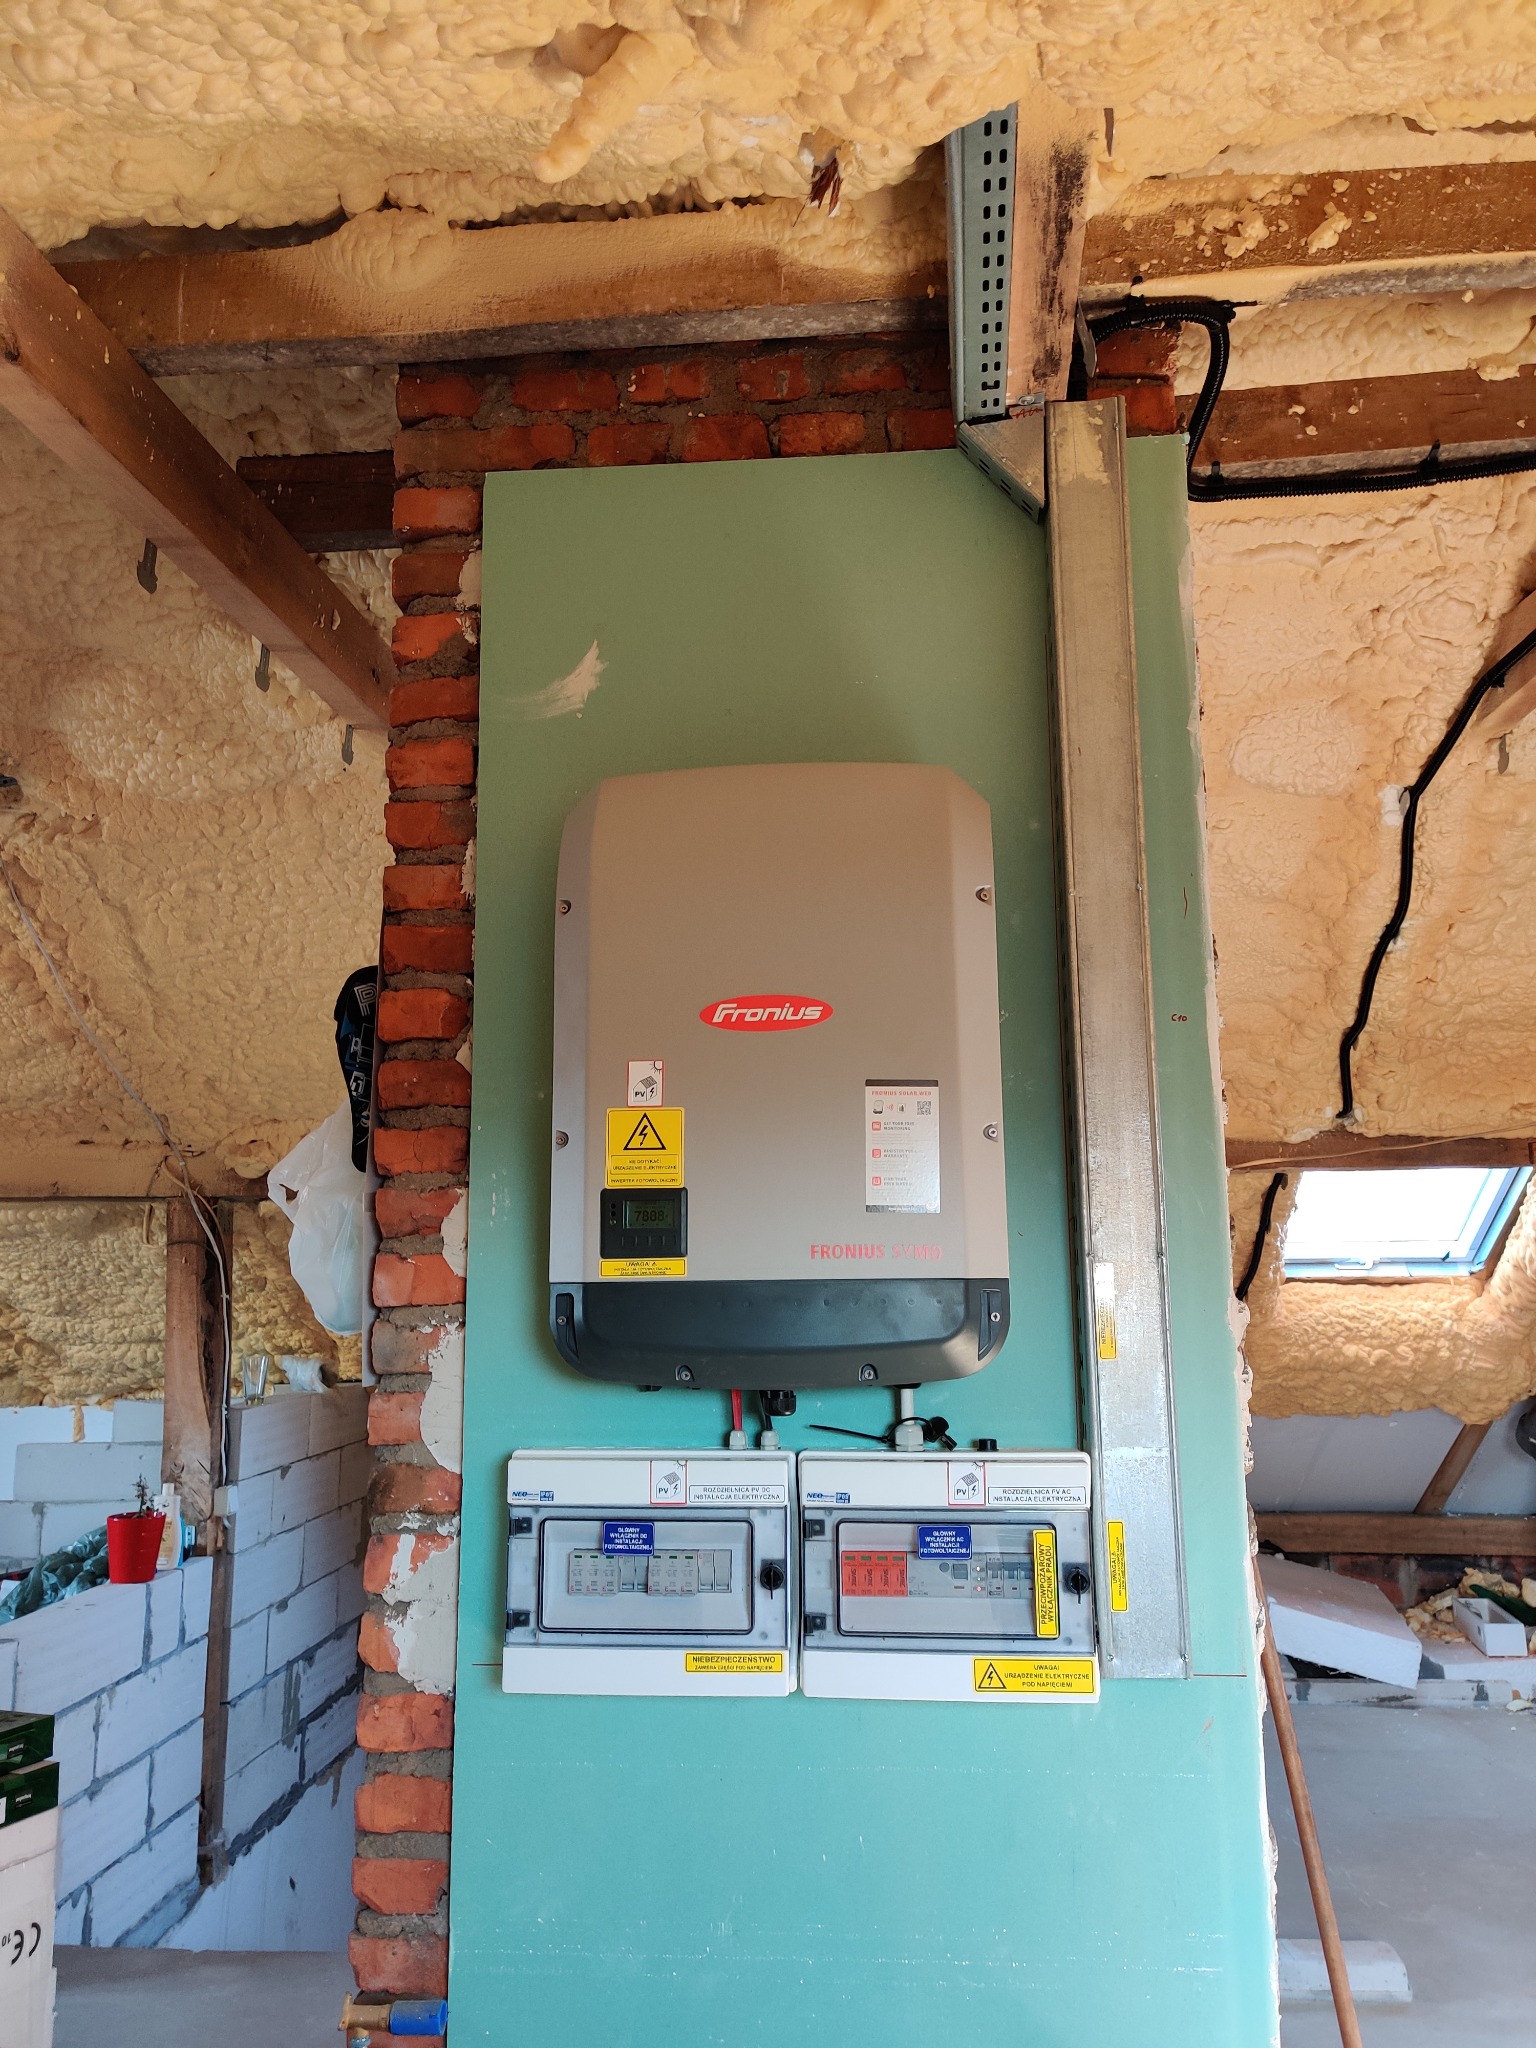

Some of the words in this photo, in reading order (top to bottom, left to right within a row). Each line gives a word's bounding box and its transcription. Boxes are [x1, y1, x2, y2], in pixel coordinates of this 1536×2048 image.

[712, 1003, 824, 1022] Fronius
[811, 1244, 885, 1259] FRONIUS
[892, 1244, 942, 1260] SYMO
[1045, 1545, 1053, 1573] PRĄDU
[1038, 1543, 1047, 1624] PRZECIWPOŻAROWY
[1046, 1576, 1054, 1622] WYŁĄCZNIK
[692, 1655, 776, 1663] NIEBEZPIECZEŃSTWO
